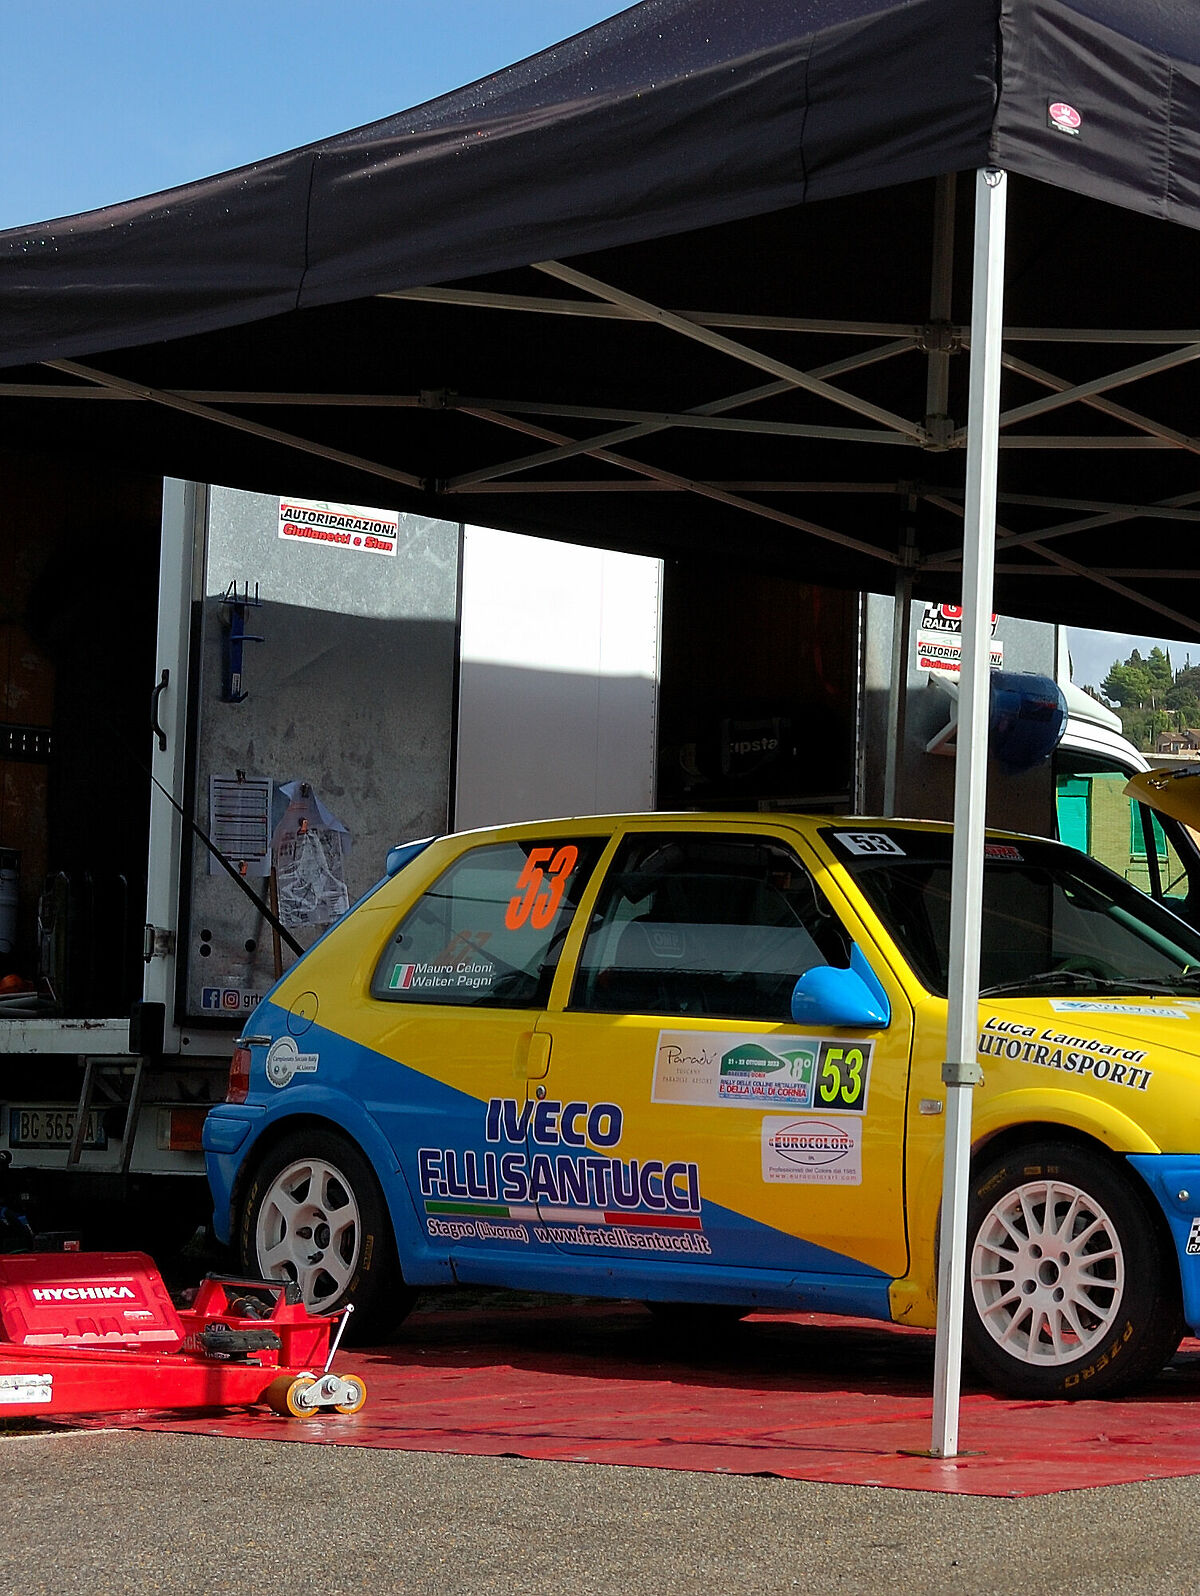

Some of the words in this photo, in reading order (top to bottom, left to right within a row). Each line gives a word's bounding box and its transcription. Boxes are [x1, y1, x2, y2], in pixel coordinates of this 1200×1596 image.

[284, 508, 395, 535] AUTORIPARAZIONI
[353, 537, 362, 546] e
[923, 618, 960, 631] RALLY
[848, 834, 897, 852] 53
[504, 844, 578, 930] 53
[414, 962, 453, 974] Mauro
[456, 962, 493, 974] Celoni
[411, 975, 454, 987] Walter
[456, 975, 493, 989] Pagni
[984, 1016, 1037, 1037] Luca
[1041, 1029, 1147, 1063] Lambardi
[978, 1033, 1153, 1090] UTOTRASPORTI
[819, 1048, 865, 1105] 53
[726, 1085, 750, 1094] DELLA
[752, 1086, 765, 1096] VAL
[767, 1087, 776, 1096] DI
[777, 1088, 807, 1098] CORNIA
[485, 1098, 624, 1148] IVECO
[418, 1147, 498, 1199] F.LLI
[500, 1152, 703, 1212] SANTUCCI
[427, 1218, 476, 1240] Stagno
[476, 1221, 530, 1244] (Livorno)
[533, 1225, 712, 1254] www.fratellisantucci.it
[32, 1286, 136, 1301] HYCHIKA
